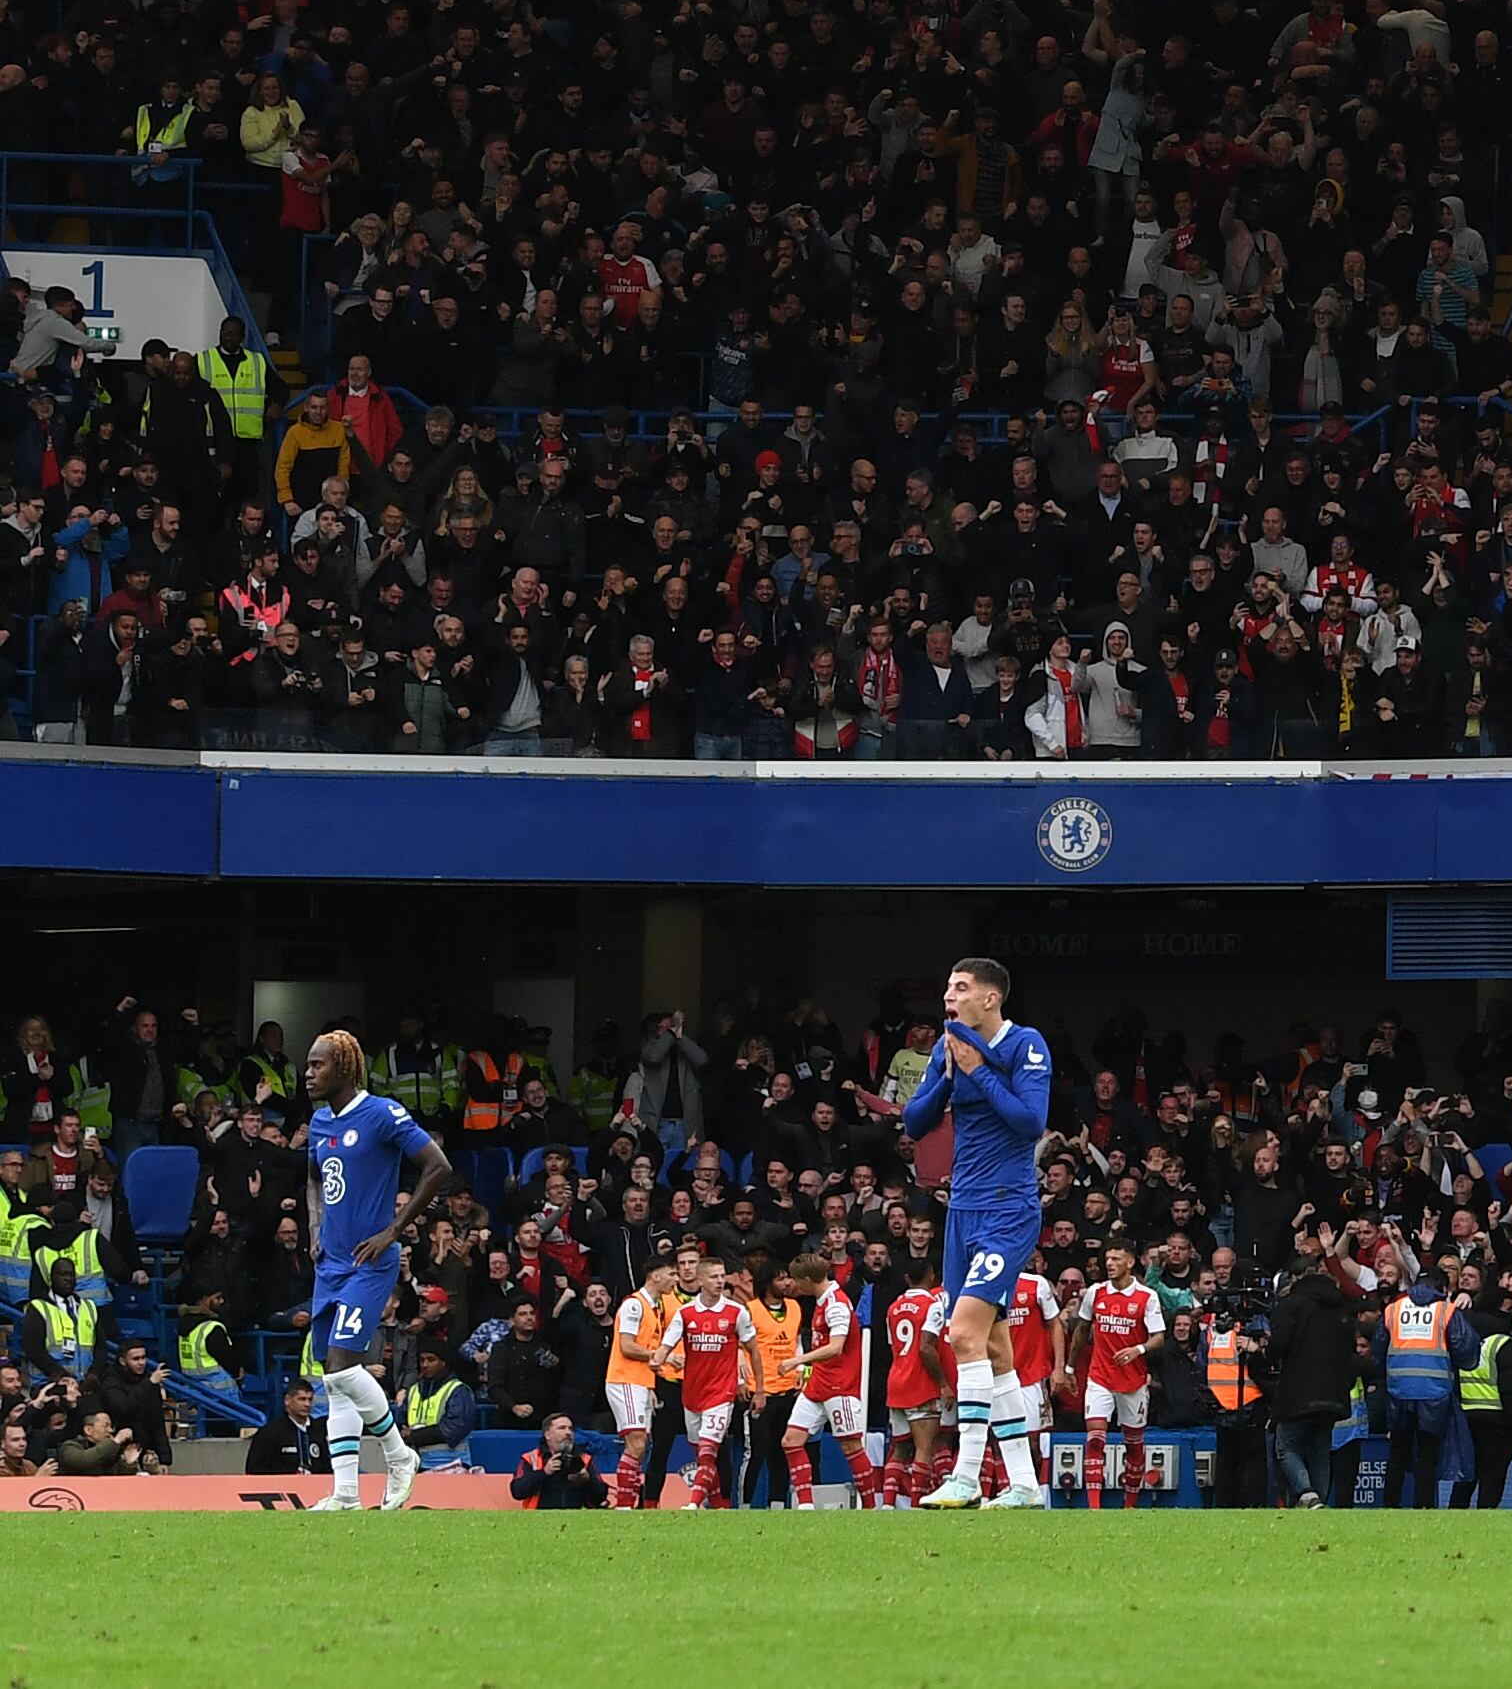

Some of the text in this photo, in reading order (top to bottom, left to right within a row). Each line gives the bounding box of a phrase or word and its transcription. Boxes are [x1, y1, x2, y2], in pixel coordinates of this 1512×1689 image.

[82, 260, 115, 318] 1
[1050, 799, 1099, 817] CHELSEA
[989, 932, 1088, 957] HOME
[1142, 932, 1242, 957] HOME
[321, 1155, 346, 1205] 3
[966, 1251, 1005, 1282] 29
[334, 1303, 363, 1335] 14
[1095, 1313, 1137, 1328] Emirates
[1400, 1310, 1434, 1325] 010
[687, 1332, 728, 1344] Emirates
[896, 1318, 914, 1356] 9
[706, 1414, 726, 1432] 35
[832, 1409, 844, 1426] 8
[1359, 1461, 1388, 1475] ELSE
[1354, 1490, 1376, 1504] LUB
